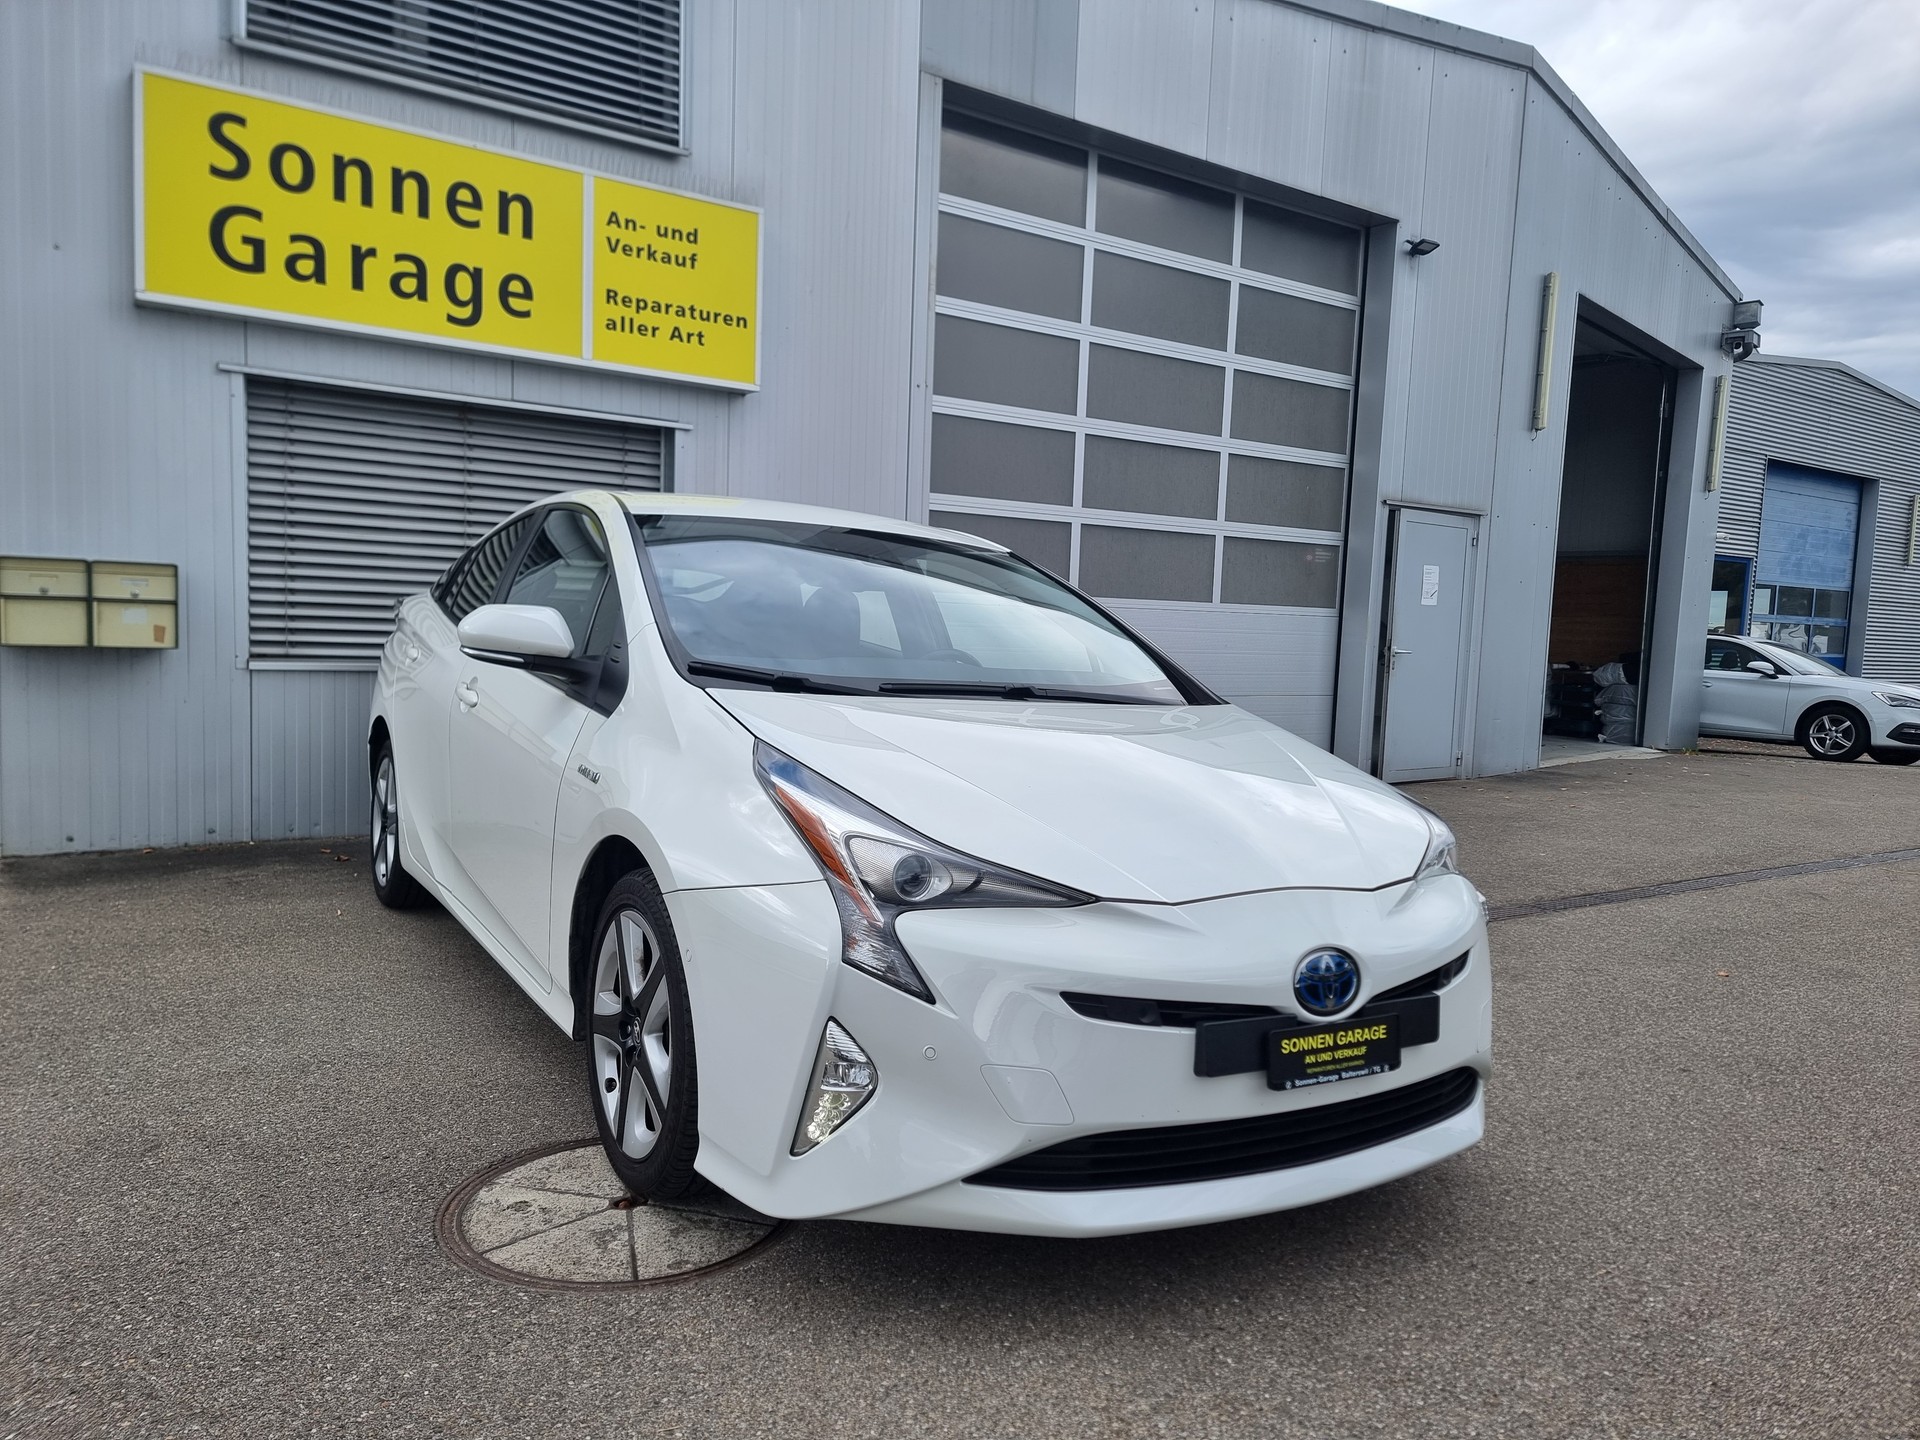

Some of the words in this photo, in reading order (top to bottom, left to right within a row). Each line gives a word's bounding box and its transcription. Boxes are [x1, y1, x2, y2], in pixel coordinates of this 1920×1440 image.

[207, 111, 534, 241] Sonnen
[606, 211, 646, 232] An-
[656, 224, 699, 245] und
[208, 205, 535, 327] Garage
[606, 236, 698, 270] Verkauf
[606, 288, 748, 329] Reparaturen
[605, 315, 660, 338] aller
[669, 326, 705, 347] Art
[1281, 1033, 1334, 1054] SONNEN
[1336, 1025, 1387, 1046] GARAGE
[1304, 1055, 1316, 1065] AN
[1317, 1051, 1333, 1063] UND
[1333, 1046, 1367, 1059] VERKAUF
[1372, 1065, 1381, 1073] TG
